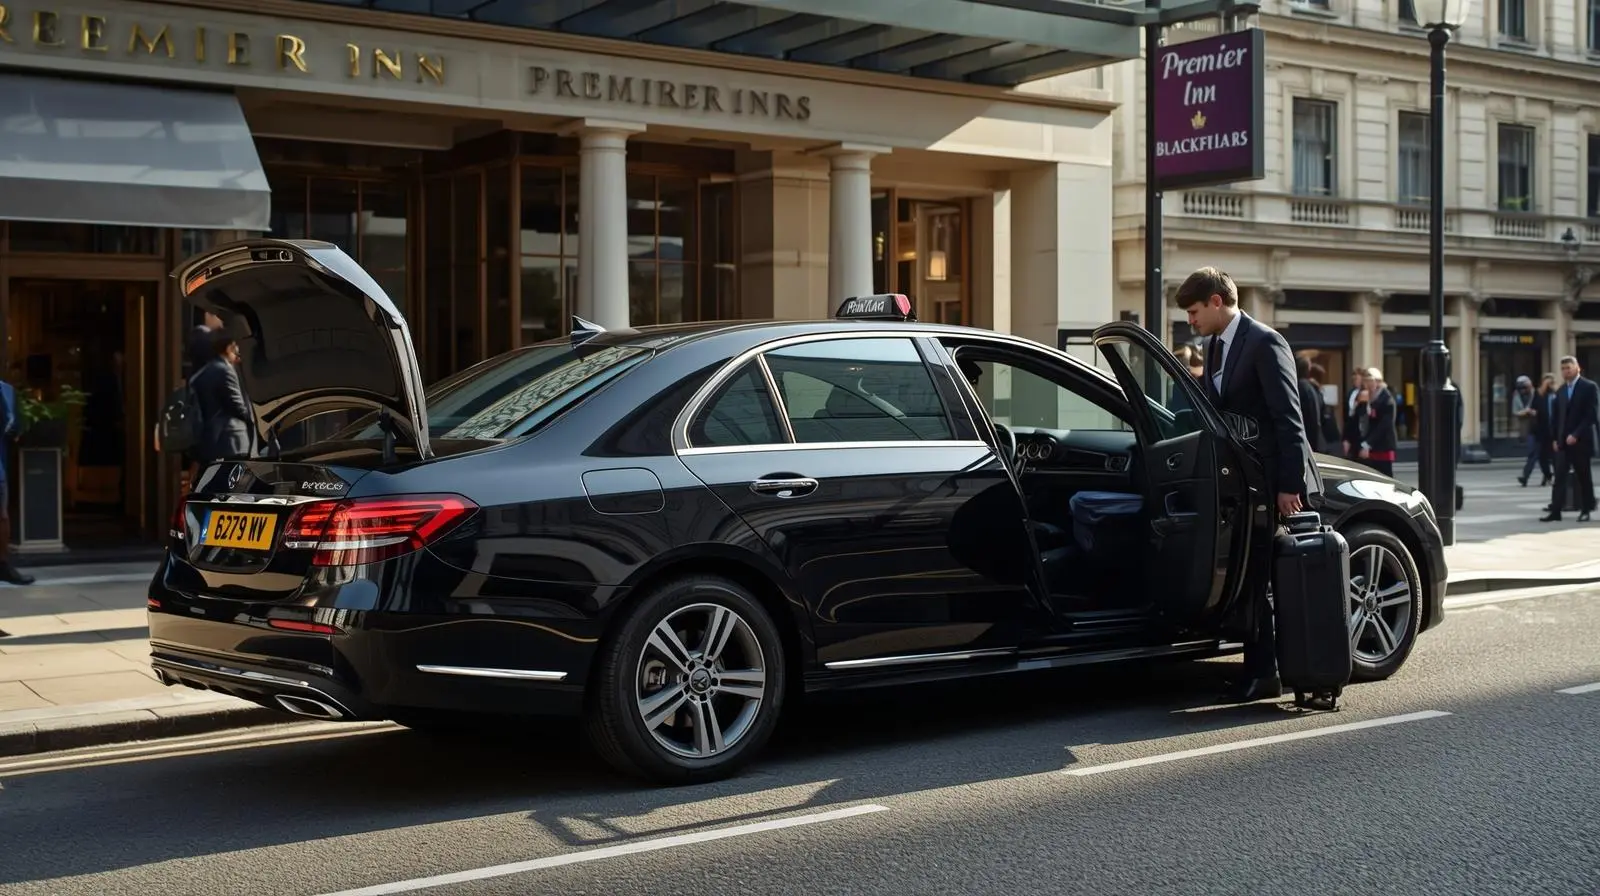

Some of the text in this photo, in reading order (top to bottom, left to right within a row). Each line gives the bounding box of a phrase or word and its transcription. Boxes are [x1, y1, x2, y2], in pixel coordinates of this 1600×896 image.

[1161, 44, 1248, 80] Premier
[1183, 81, 1217, 106] Inn
[214, 514, 248, 541] 6279
